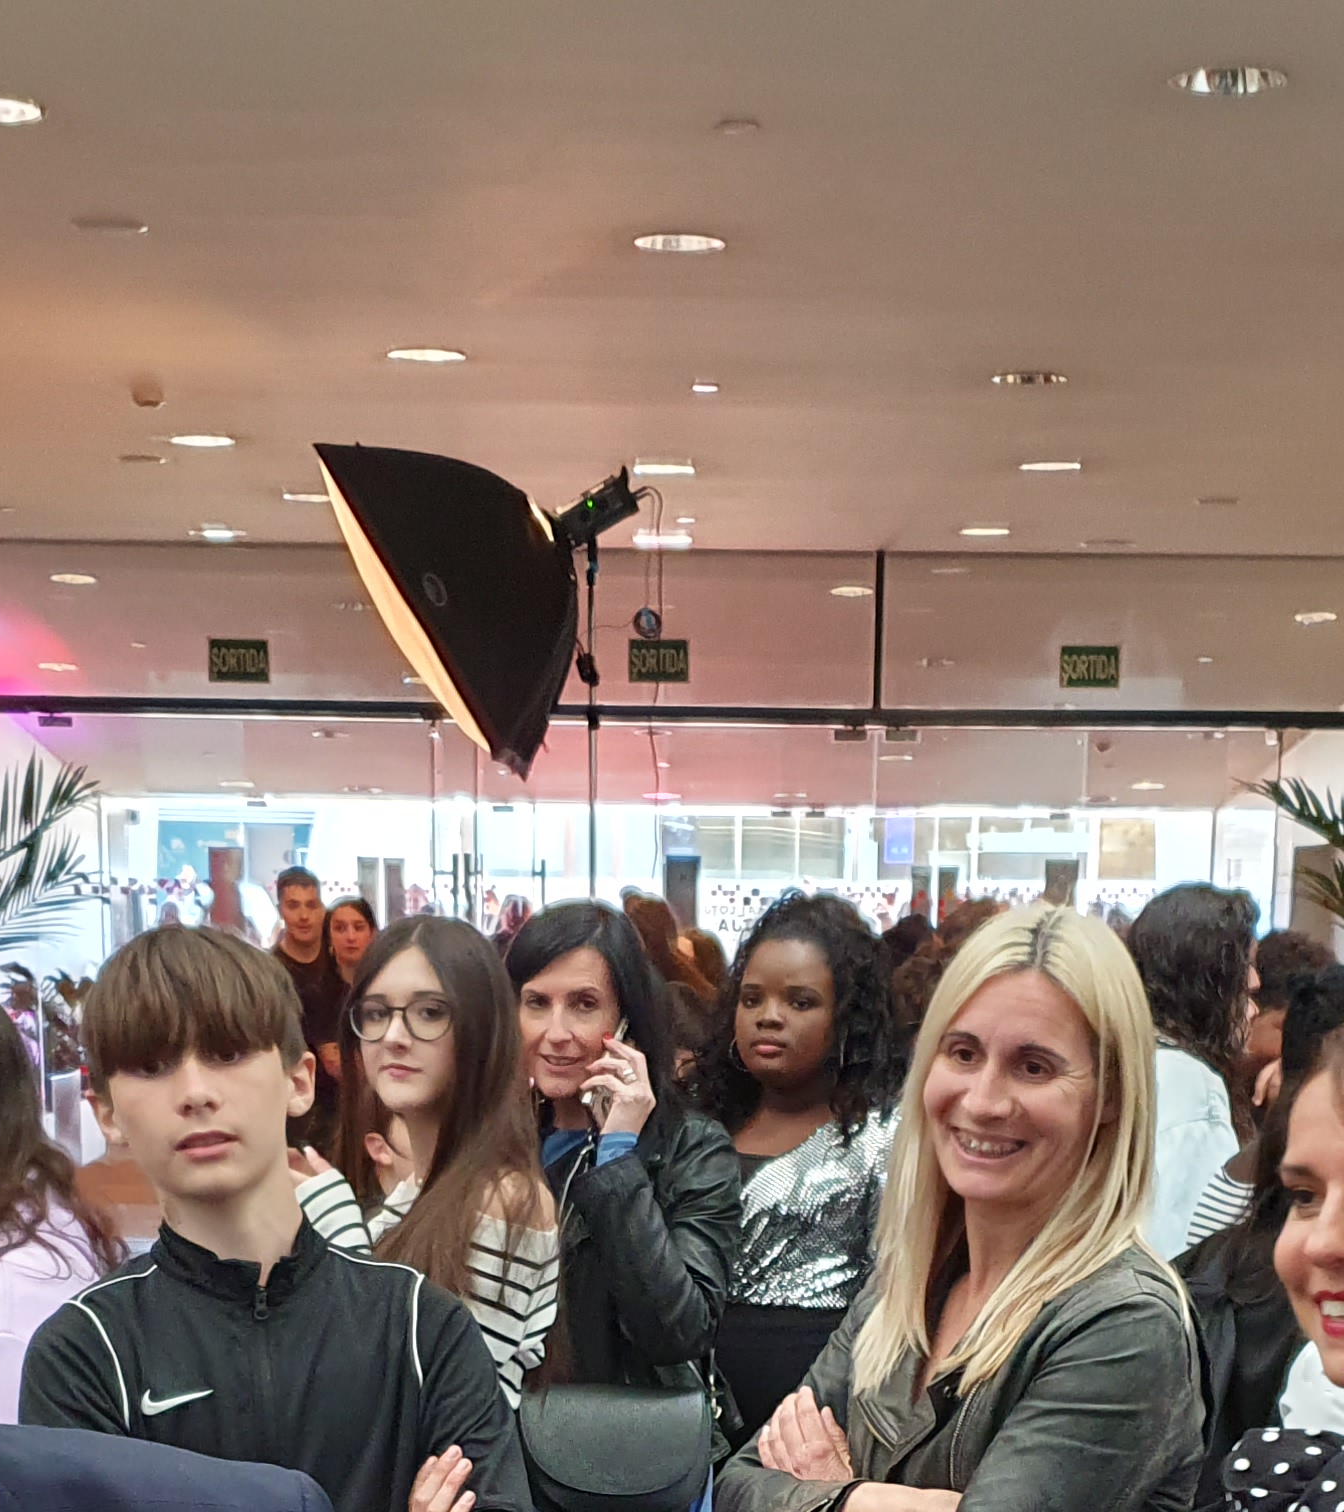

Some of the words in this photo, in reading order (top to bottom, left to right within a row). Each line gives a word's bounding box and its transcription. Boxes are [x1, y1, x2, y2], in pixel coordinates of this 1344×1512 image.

[211, 647, 267, 673] SORTIDA
[631, 648, 687, 673] SORTIDA
[1062, 655, 1117, 680] SORTIDA
